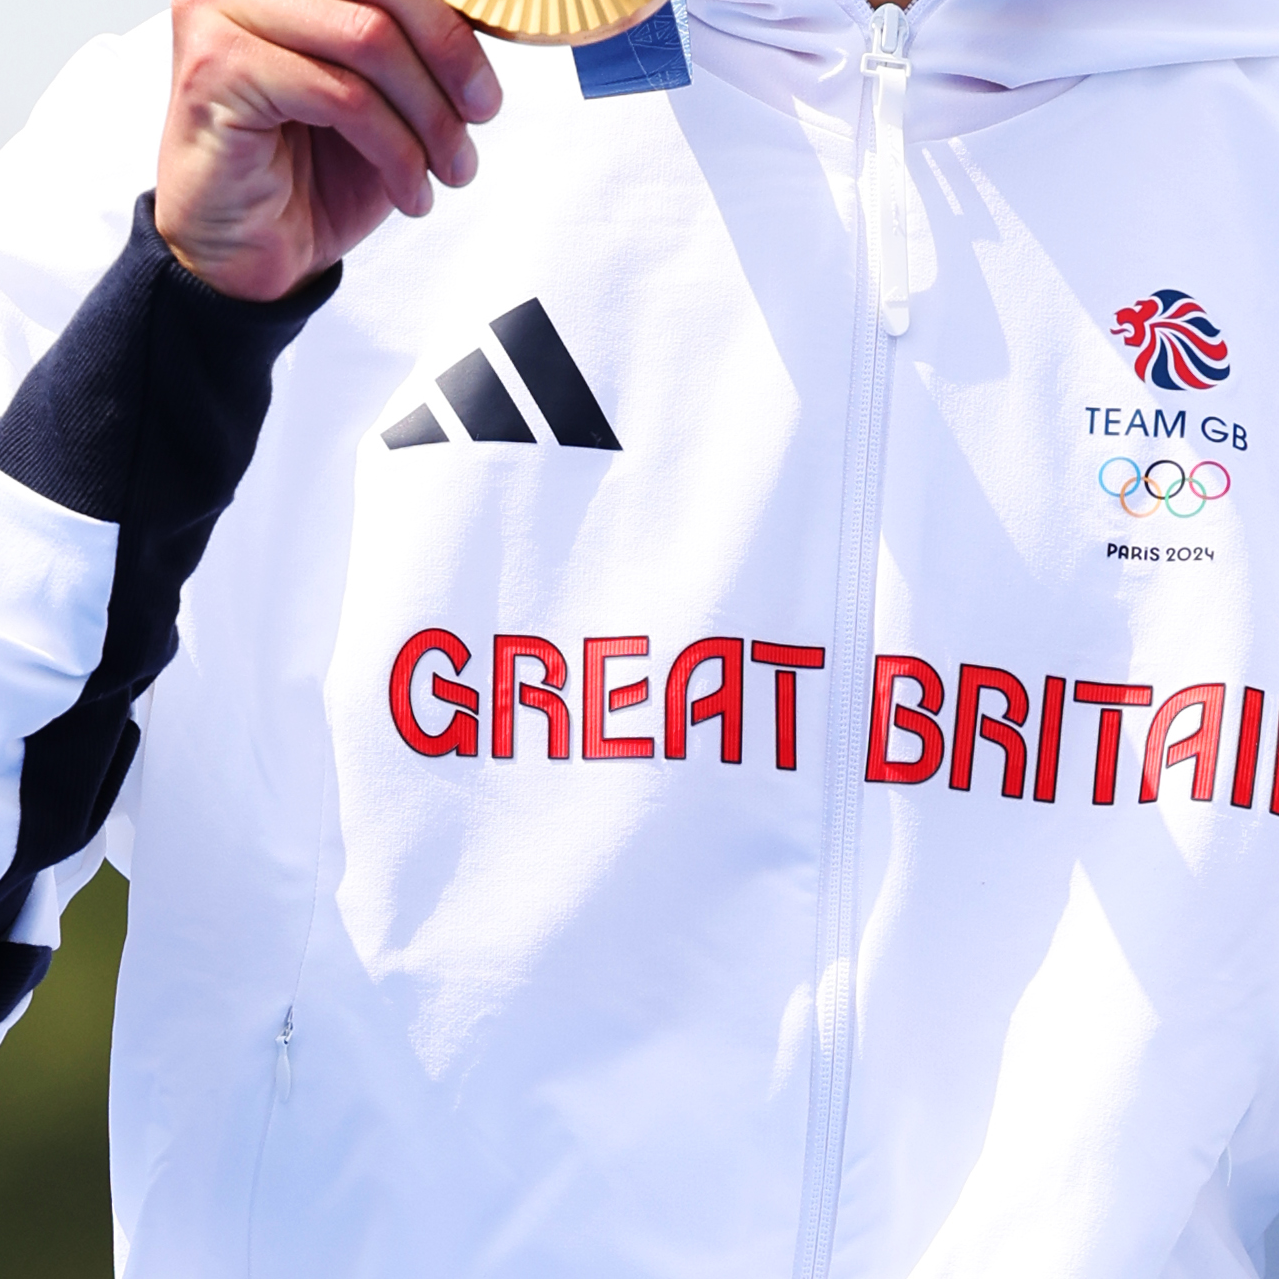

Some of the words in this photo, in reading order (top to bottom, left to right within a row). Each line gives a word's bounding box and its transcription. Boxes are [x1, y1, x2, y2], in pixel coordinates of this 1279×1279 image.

[1086, 407, 1186, 439] TEAM
[1201, 416, 1248, 452] GB
[1166, 547, 1215, 562] 2024
[389, 628, 826, 771] GREAT
